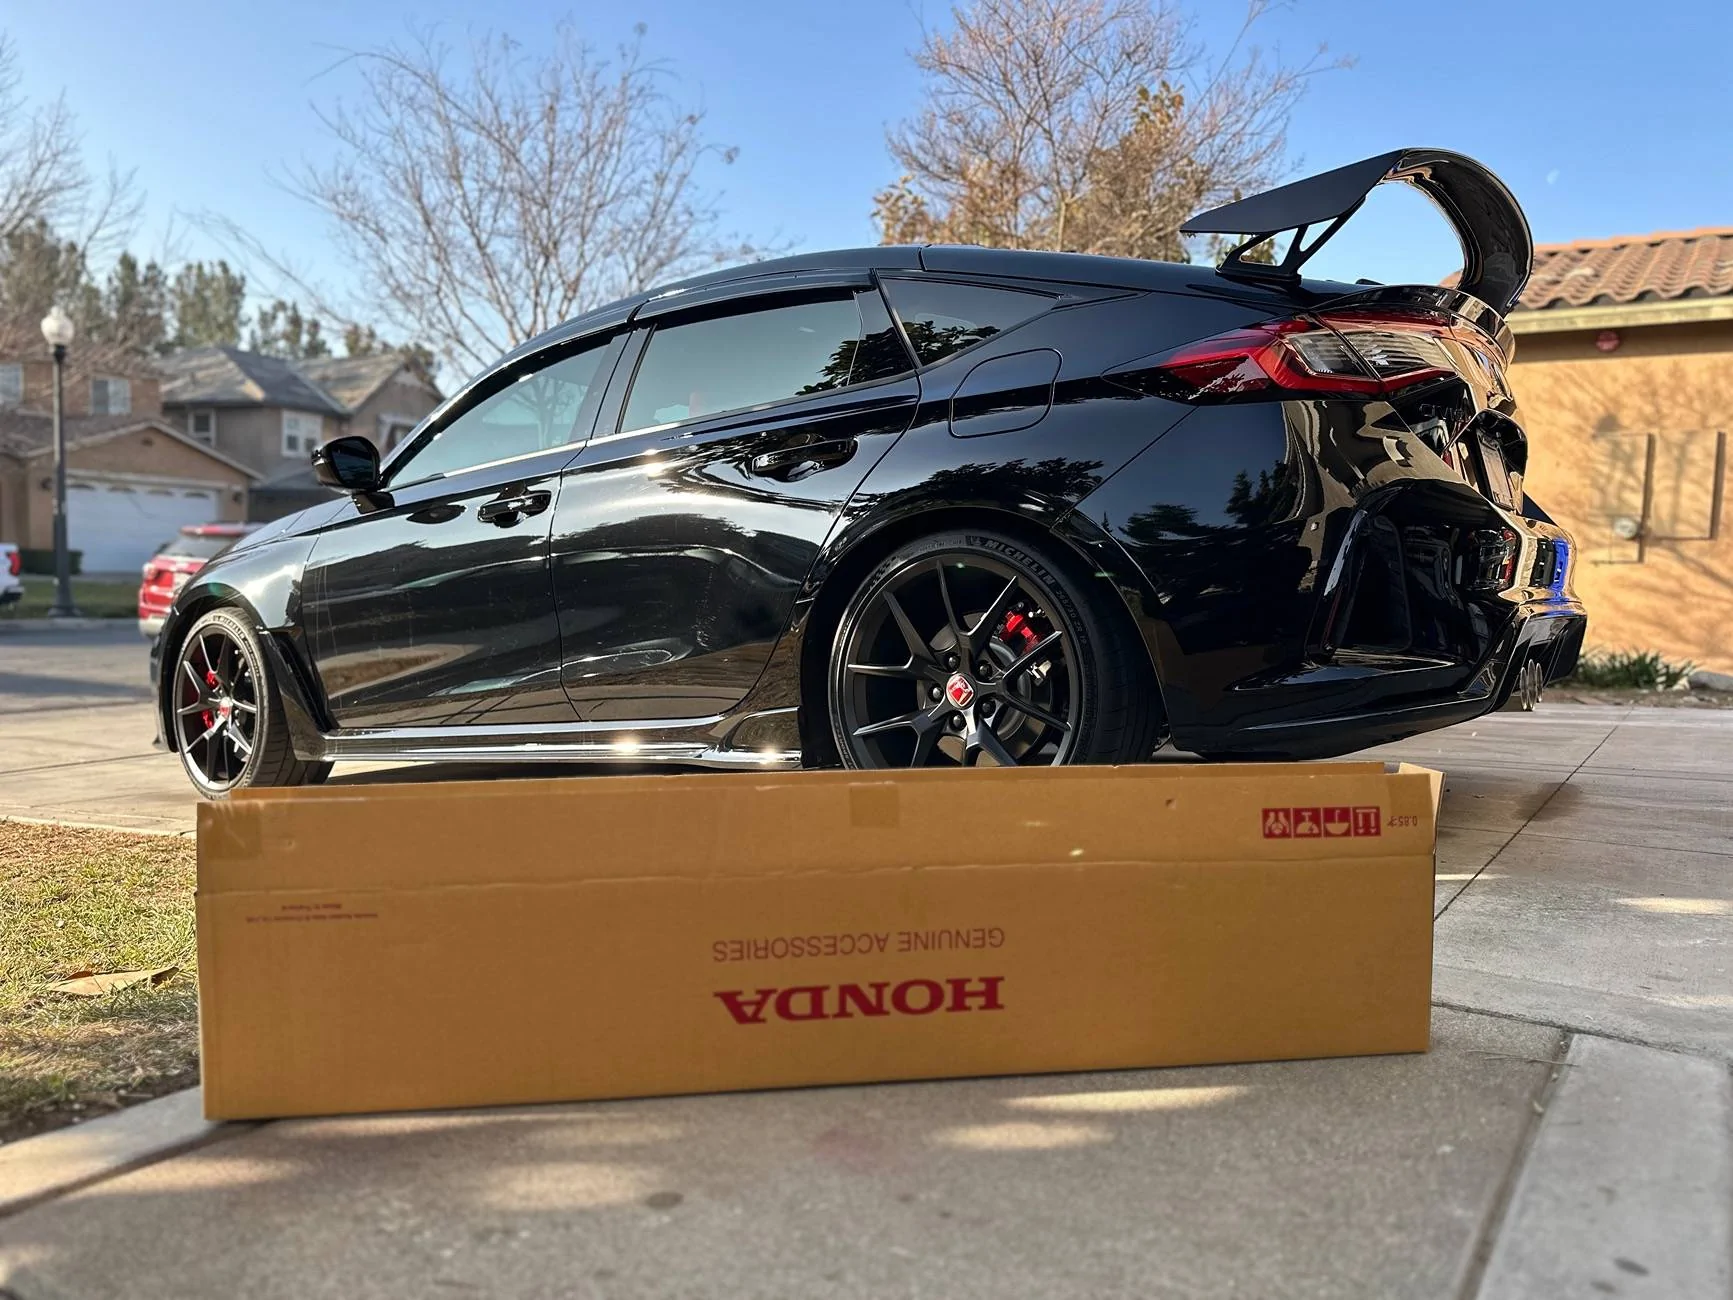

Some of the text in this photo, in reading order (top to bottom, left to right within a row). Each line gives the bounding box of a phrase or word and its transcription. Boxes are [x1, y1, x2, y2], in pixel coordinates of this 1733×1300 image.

[985, 541, 1056, 585] MICHELIN
[713, 928, 1005, 962] GENUINE ACCESSORIES
[714, 977, 1005, 1025] HONDA
